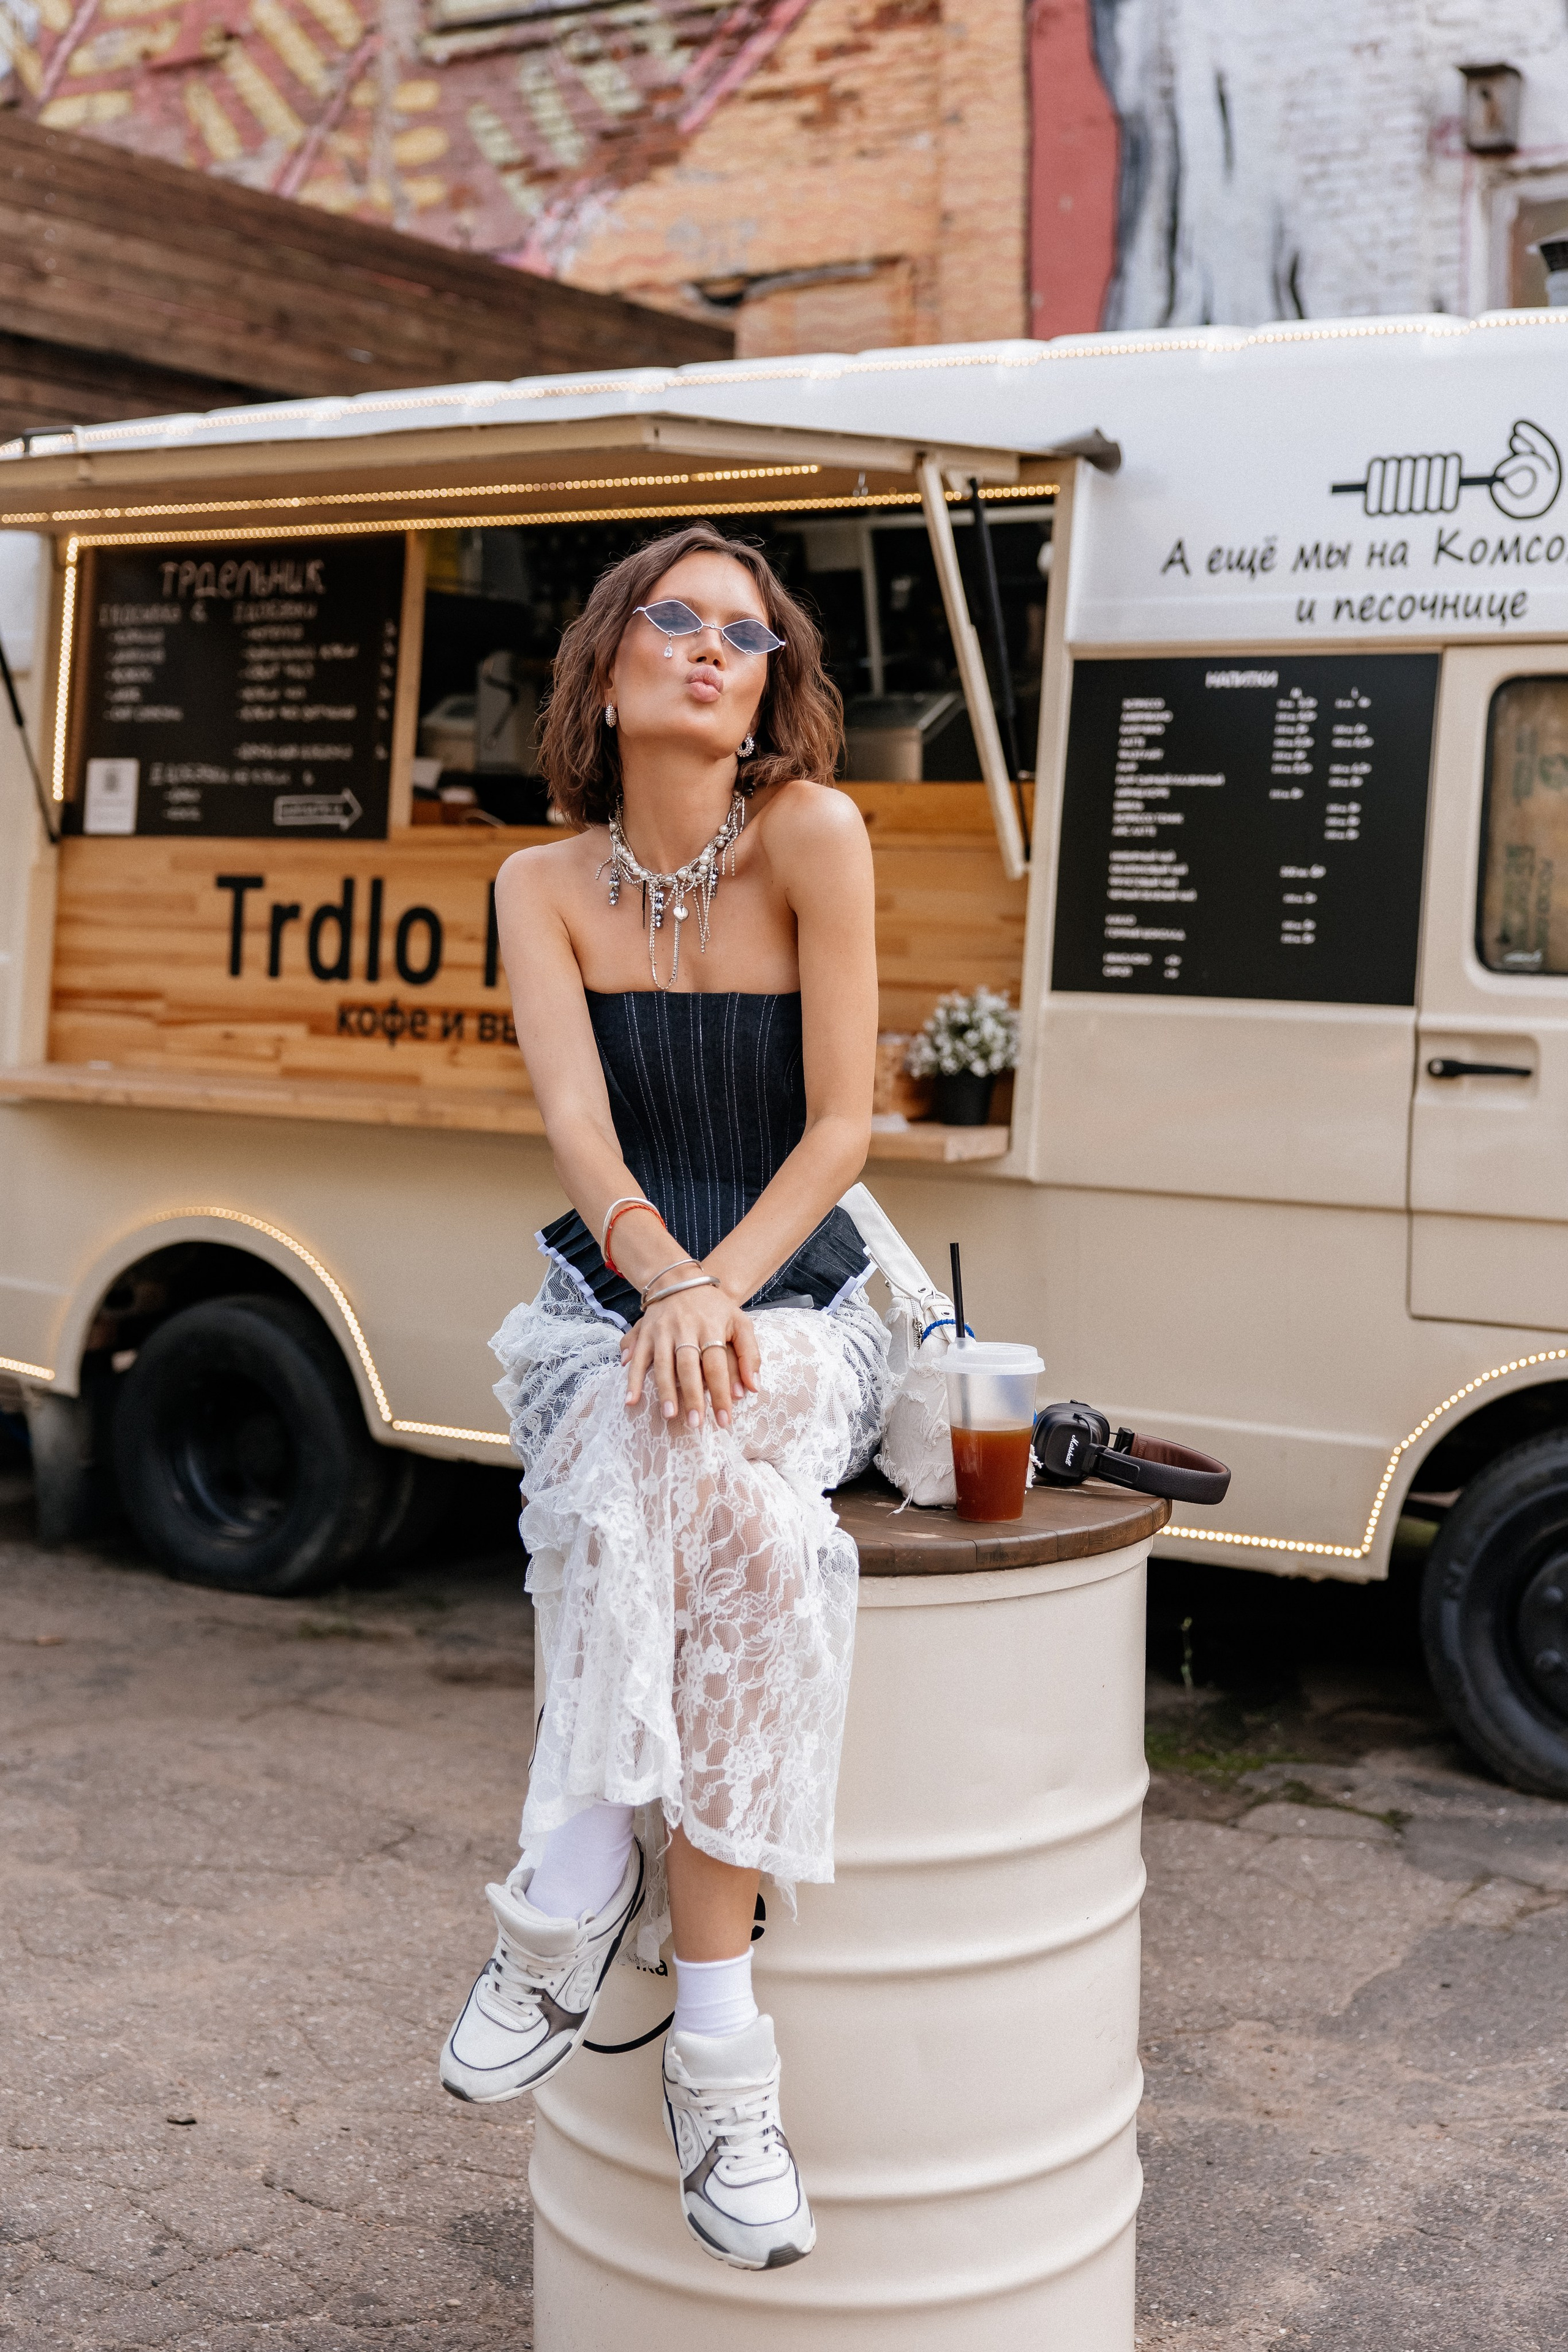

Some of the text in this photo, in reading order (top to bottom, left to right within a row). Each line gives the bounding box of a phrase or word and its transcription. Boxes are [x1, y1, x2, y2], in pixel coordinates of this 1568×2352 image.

[1161, 529, 1568, 580] А ещё мы на Комсо
[1296, 591, 1529, 628] и песочнице
[216, 875, 443, 985] Trdlo
[337, 998, 428, 1049] кофе
[442, 1011, 464, 1040] и
[1065, 1434, 1079, 1466] Marshall
